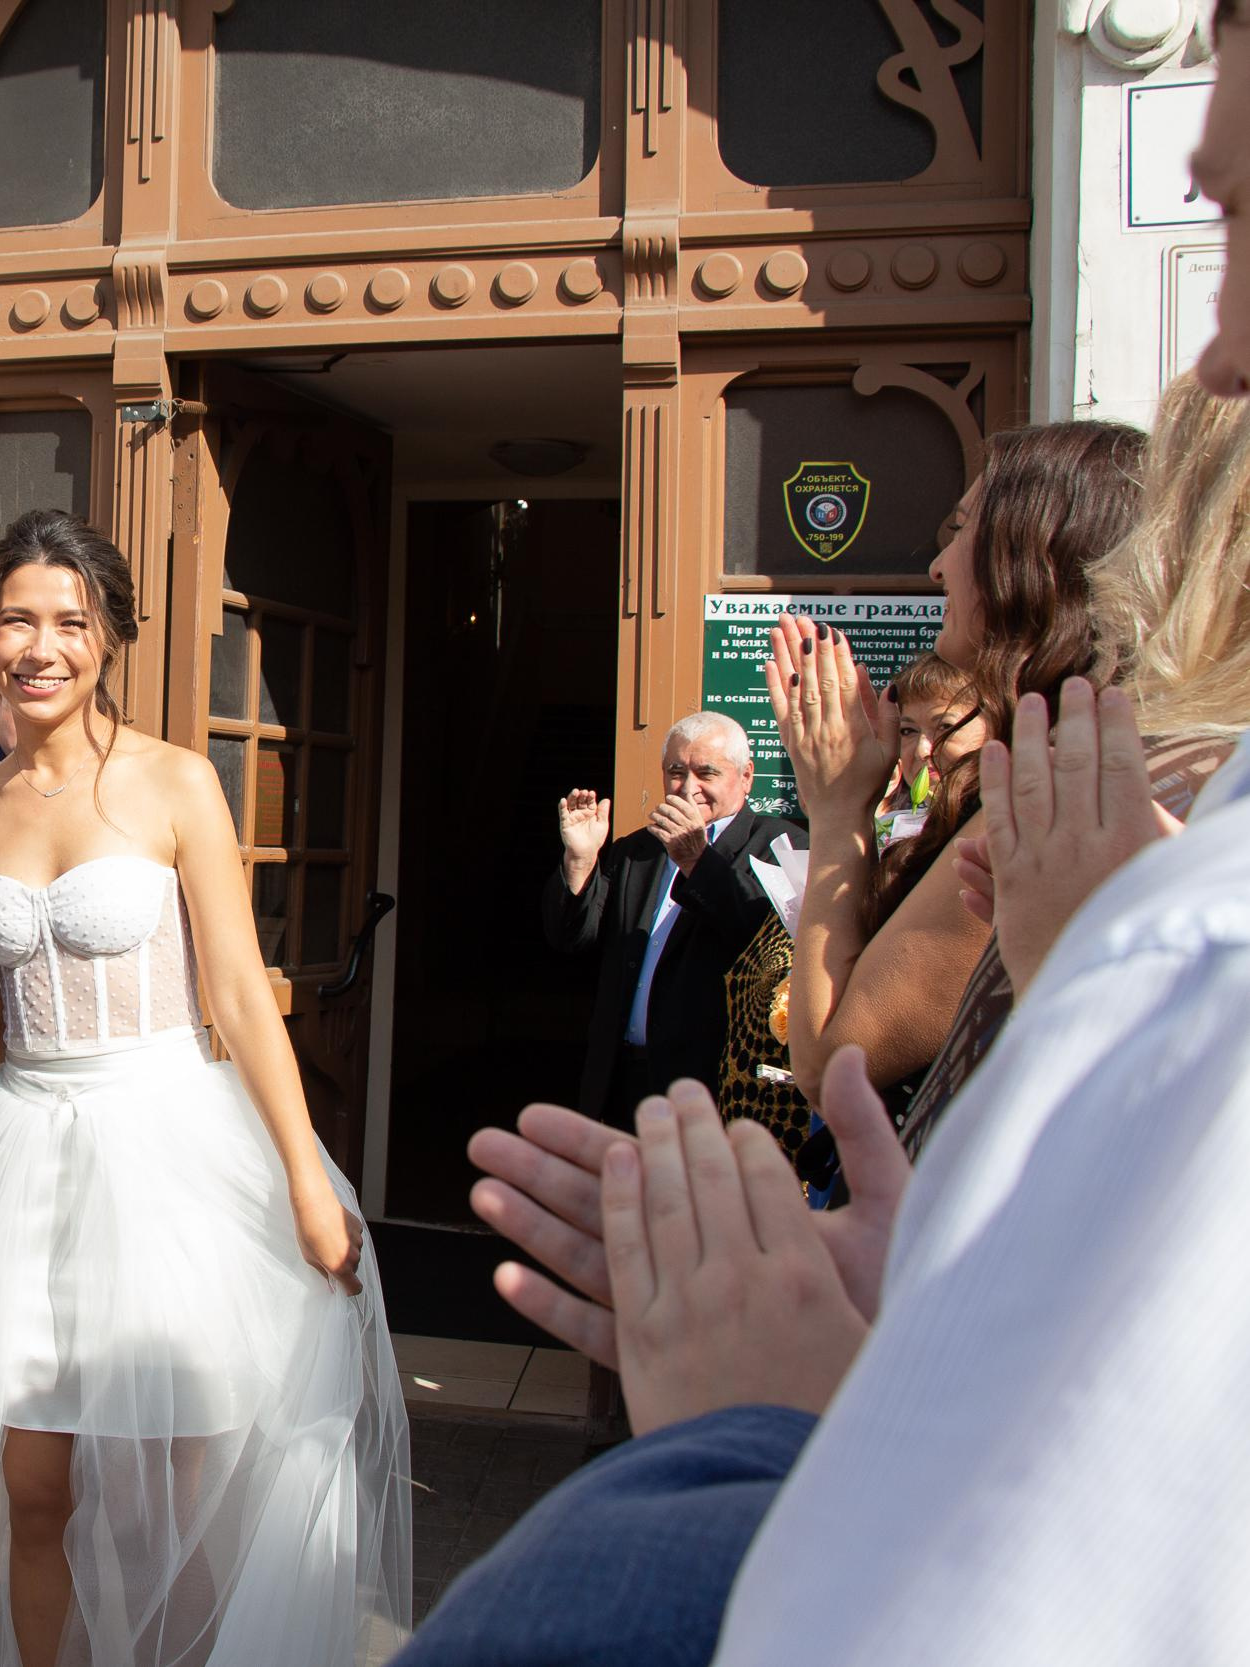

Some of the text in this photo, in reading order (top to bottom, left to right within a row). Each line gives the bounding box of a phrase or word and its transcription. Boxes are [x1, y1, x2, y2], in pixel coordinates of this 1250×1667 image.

[1188, 263, 1227, 273] Депар
[795, 484, 859, 493] ОХРАНЯЕТСЯ
[711, 600, 942, 620] Уважаемые гражда
[728, 625, 752, 637] При
[756, 627, 770, 637] ре
[919, 626, 942, 639] бра
[721, 639, 729, 647] в
[731, 639, 768, 648] целях
[852, 641, 904, 649] чистоты
[712, 651, 720, 659] и
[723, 651, 738, 659] во
[851, 654, 895, 662] атизма
[866, 666, 891, 674] ела
[724, 695, 770, 703] осыпат
[751, 719, 767, 727] не
[757, 750, 789, 760] прил
[771, 779, 794, 790] Зар
